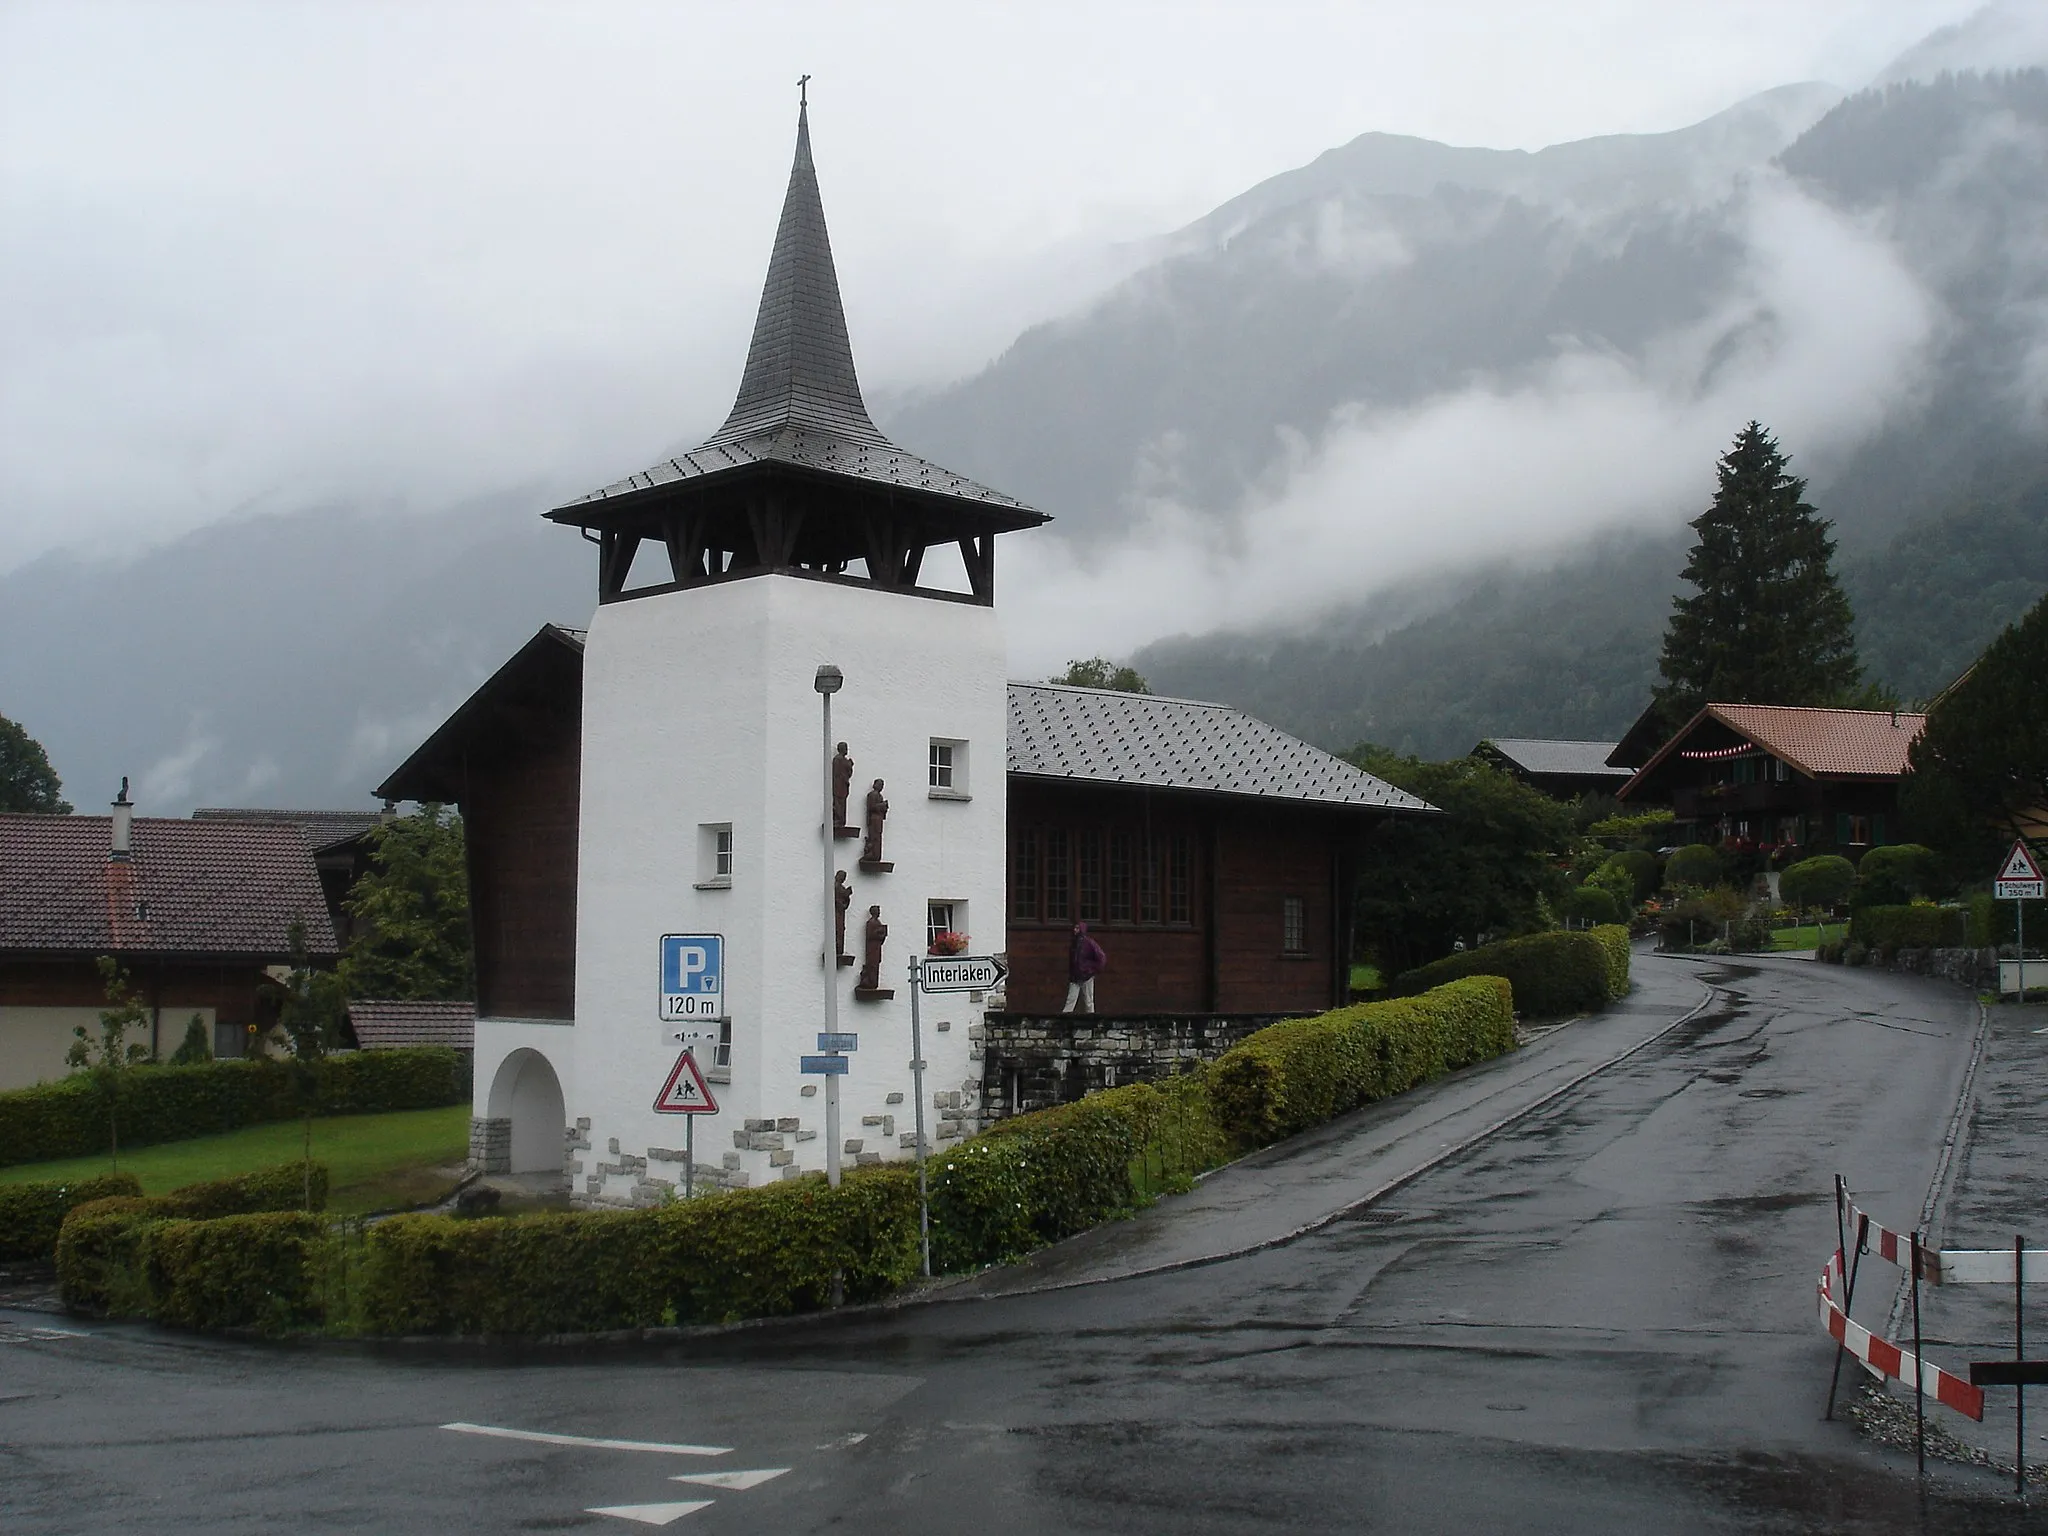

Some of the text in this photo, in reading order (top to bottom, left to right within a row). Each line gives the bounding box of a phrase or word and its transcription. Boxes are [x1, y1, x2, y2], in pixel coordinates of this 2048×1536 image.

[679, 946, 706, 988] P
[928, 964, 991, 983] Interlaken
[669, 996, 714, 1014] 120 m
